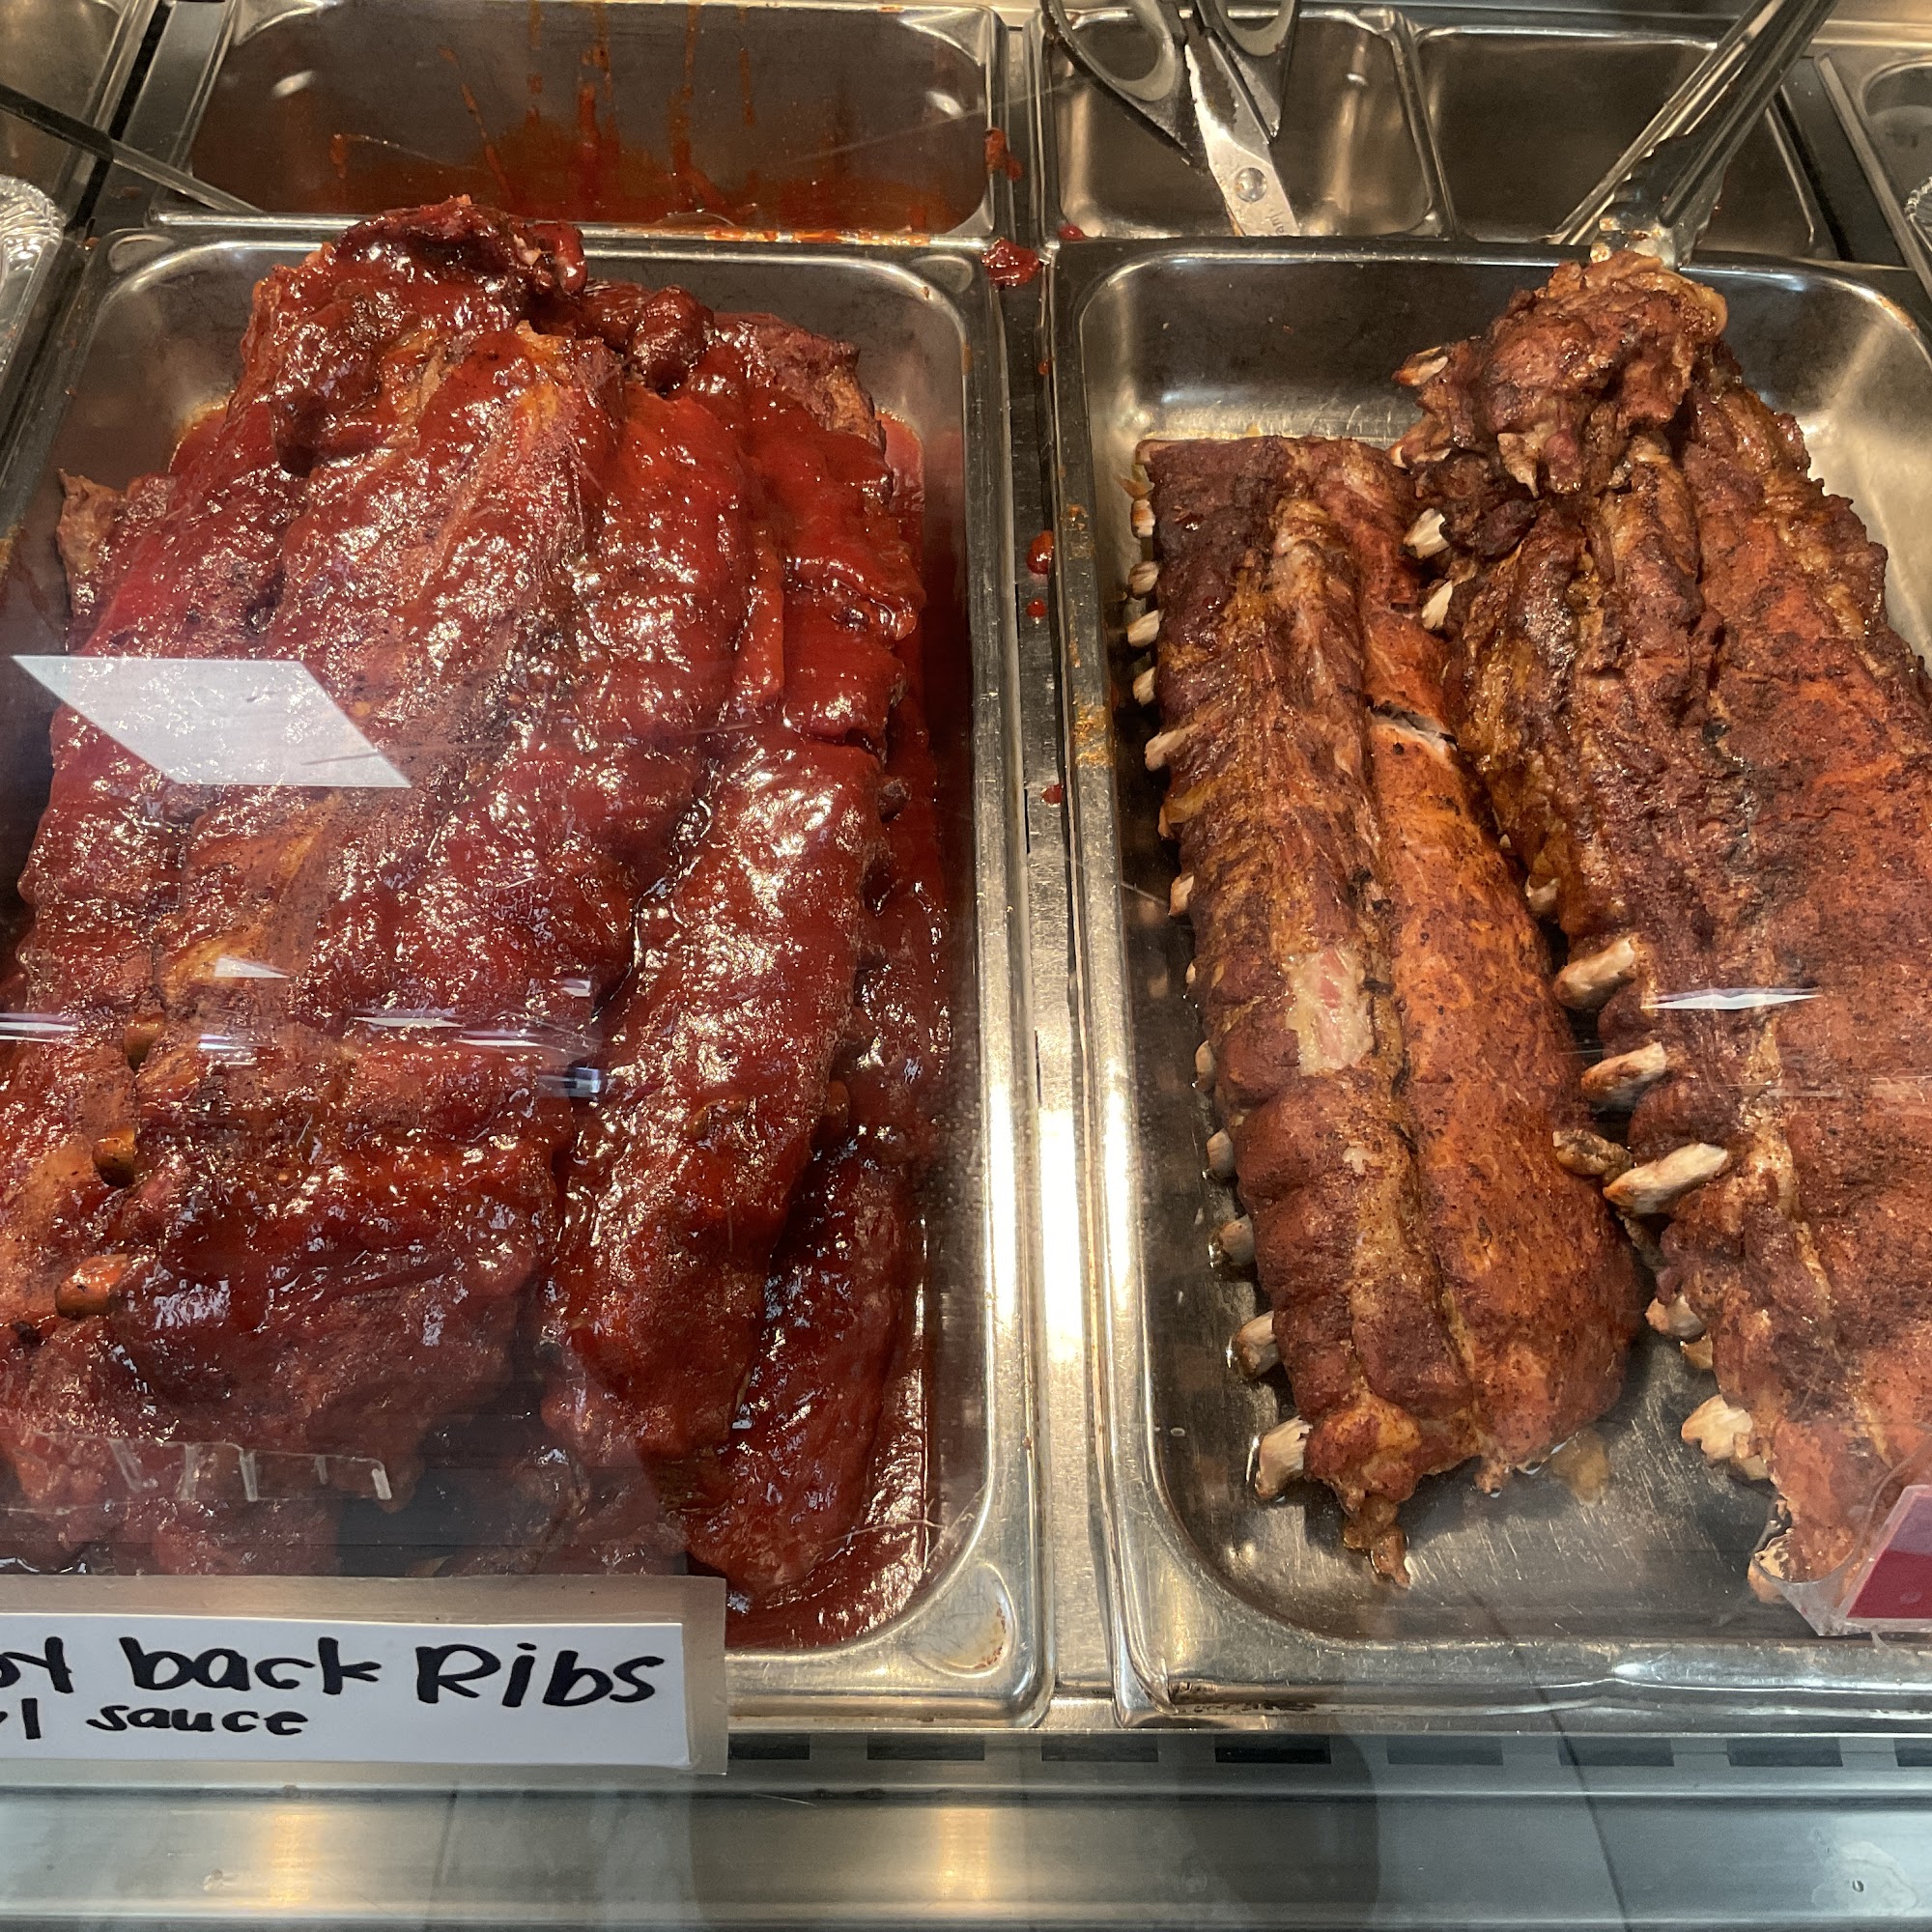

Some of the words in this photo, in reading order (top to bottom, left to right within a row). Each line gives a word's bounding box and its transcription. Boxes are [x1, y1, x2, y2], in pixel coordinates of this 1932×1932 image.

[118, 1636, 382, 1695] back
[415, 1642, 666, 1708] Ribs
[85, 1704, 309, 1736] sauce
